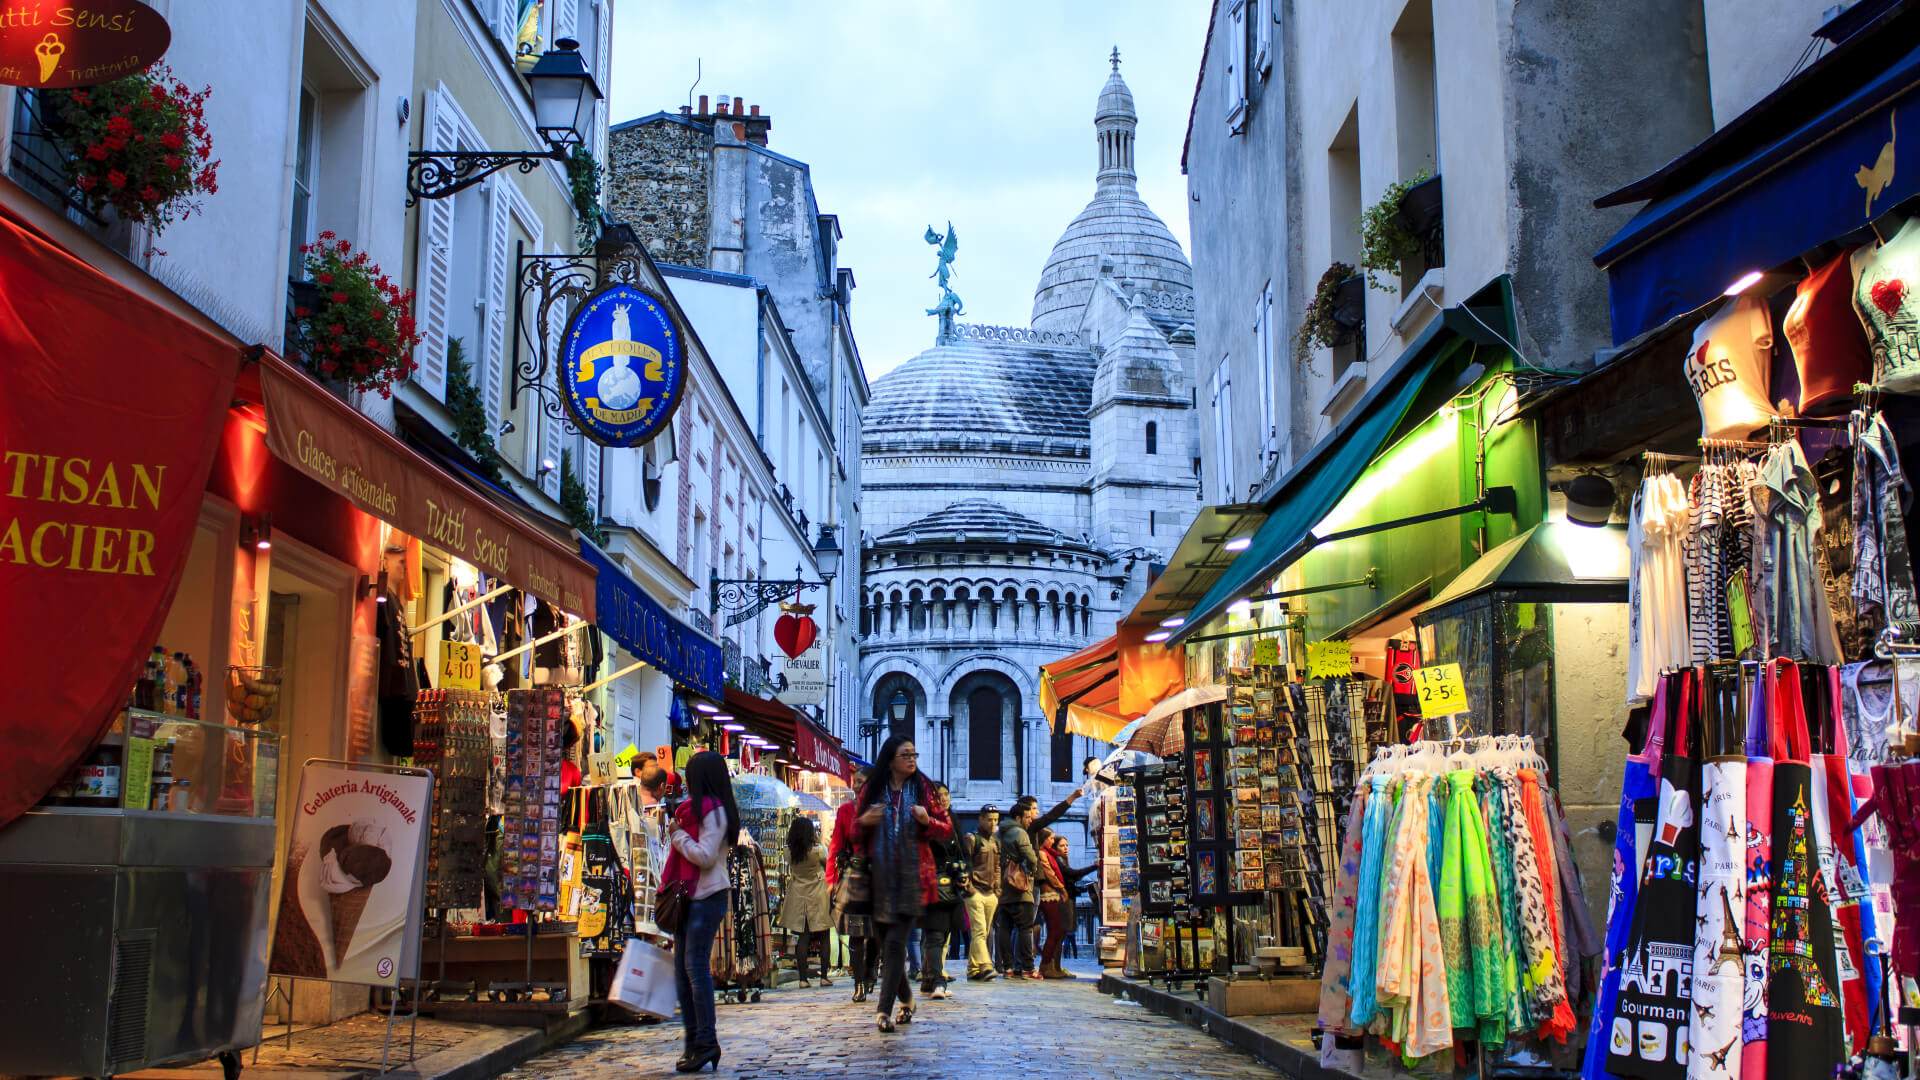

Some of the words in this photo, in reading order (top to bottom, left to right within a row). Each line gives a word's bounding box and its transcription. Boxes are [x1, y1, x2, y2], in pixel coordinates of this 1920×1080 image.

[50, 8, 136, 32] Sensi
[67, 55, 140, 80] Trattoria
[1691, 357, 1738, 402] ARIS
[595, 409, 608, 418] DE
[611, 408, 643, 422] MARIE
[4, 451, 167, 511] TISAN
[297, 429, 337, 481] Glaces
[426, 498, 466, 552] Tutti
[472, 527, 511, 576] Sensi
[0, 517, 156, 576] ACIER
[786, 659, 820, 670] CHEVALIER
[303, 779, 358, 816] Gelateria
[360, 779, 417, 825] Artigianale
[1621, 997, 1690, 1021] Gourman
